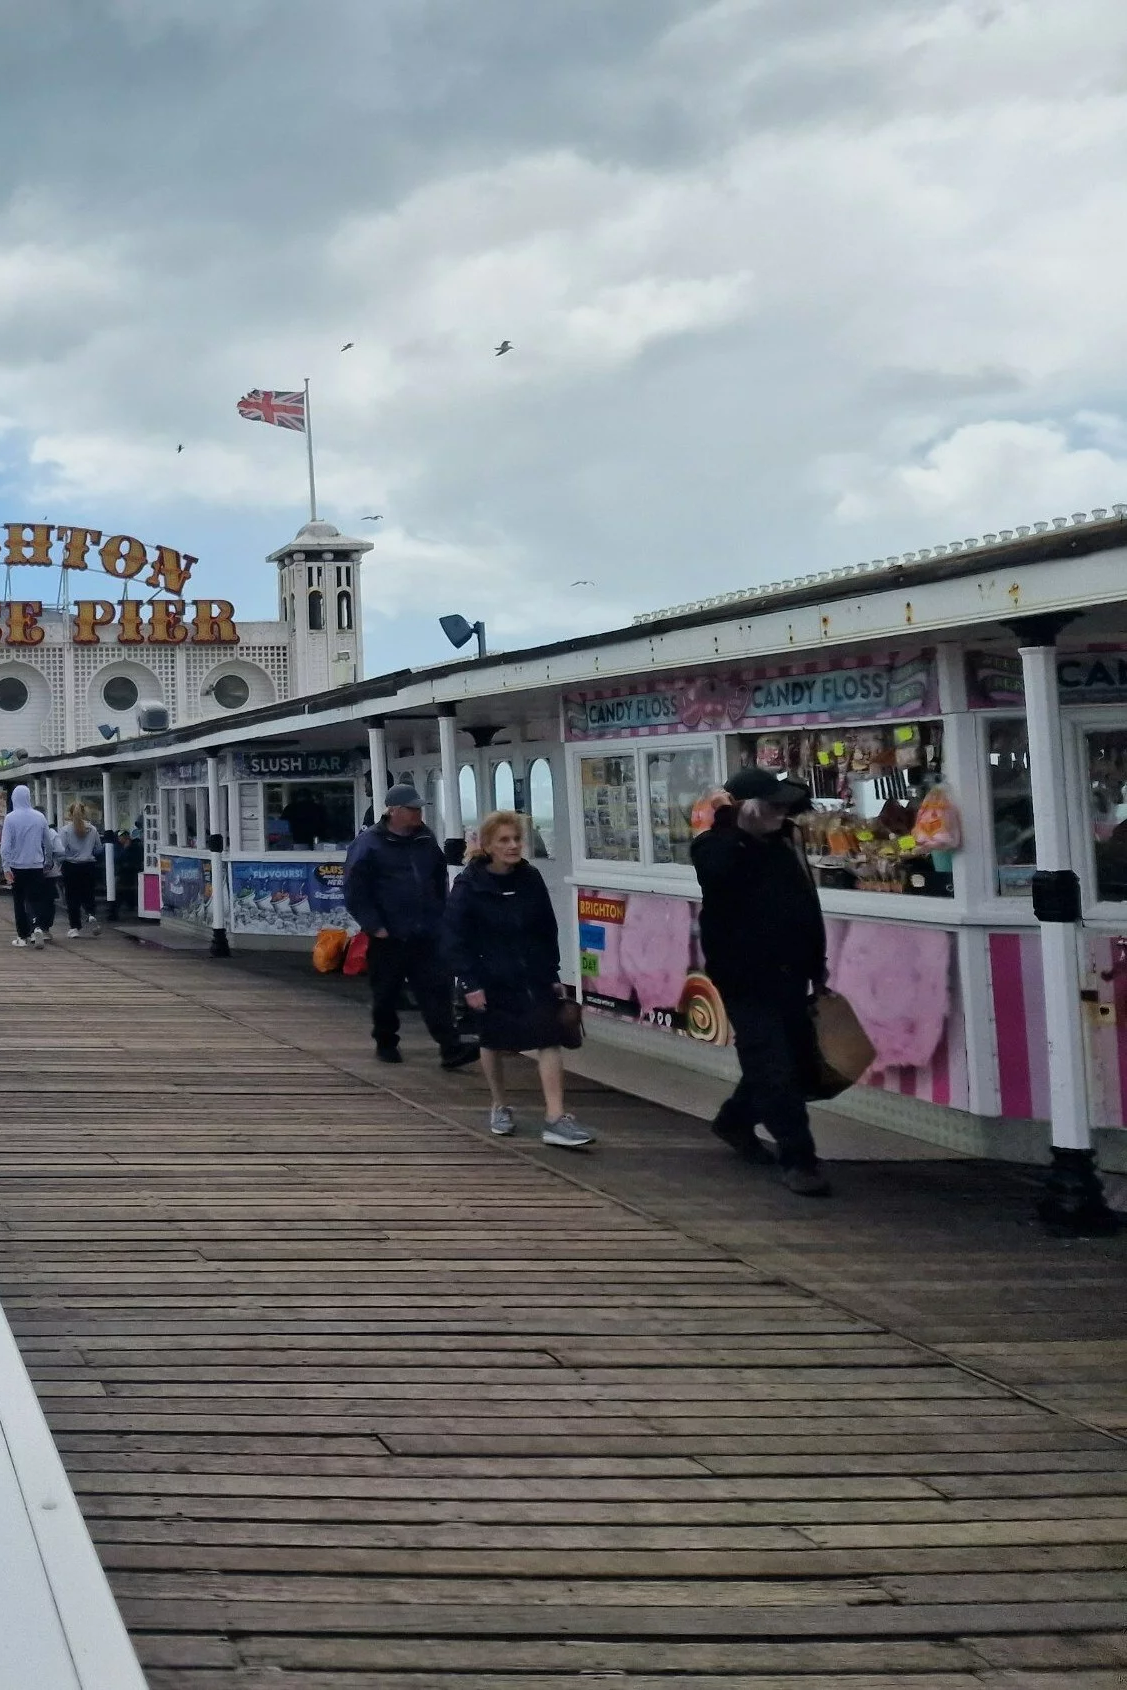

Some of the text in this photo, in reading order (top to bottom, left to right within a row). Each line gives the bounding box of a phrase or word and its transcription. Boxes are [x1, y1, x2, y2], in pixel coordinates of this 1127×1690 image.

[74, 599, 241, 646] PIER
[751, 680, 817, 709] CANDY
[822, 672, 885, 702] FLOSS
[588, 695, 678, 724] CANDY FLOSS
[251, 755, 341, 773] SLUSH BAR
[253, 868, 304, 879] FLAVOURS!
[580, 900, 624, 919] BRIGHTON
